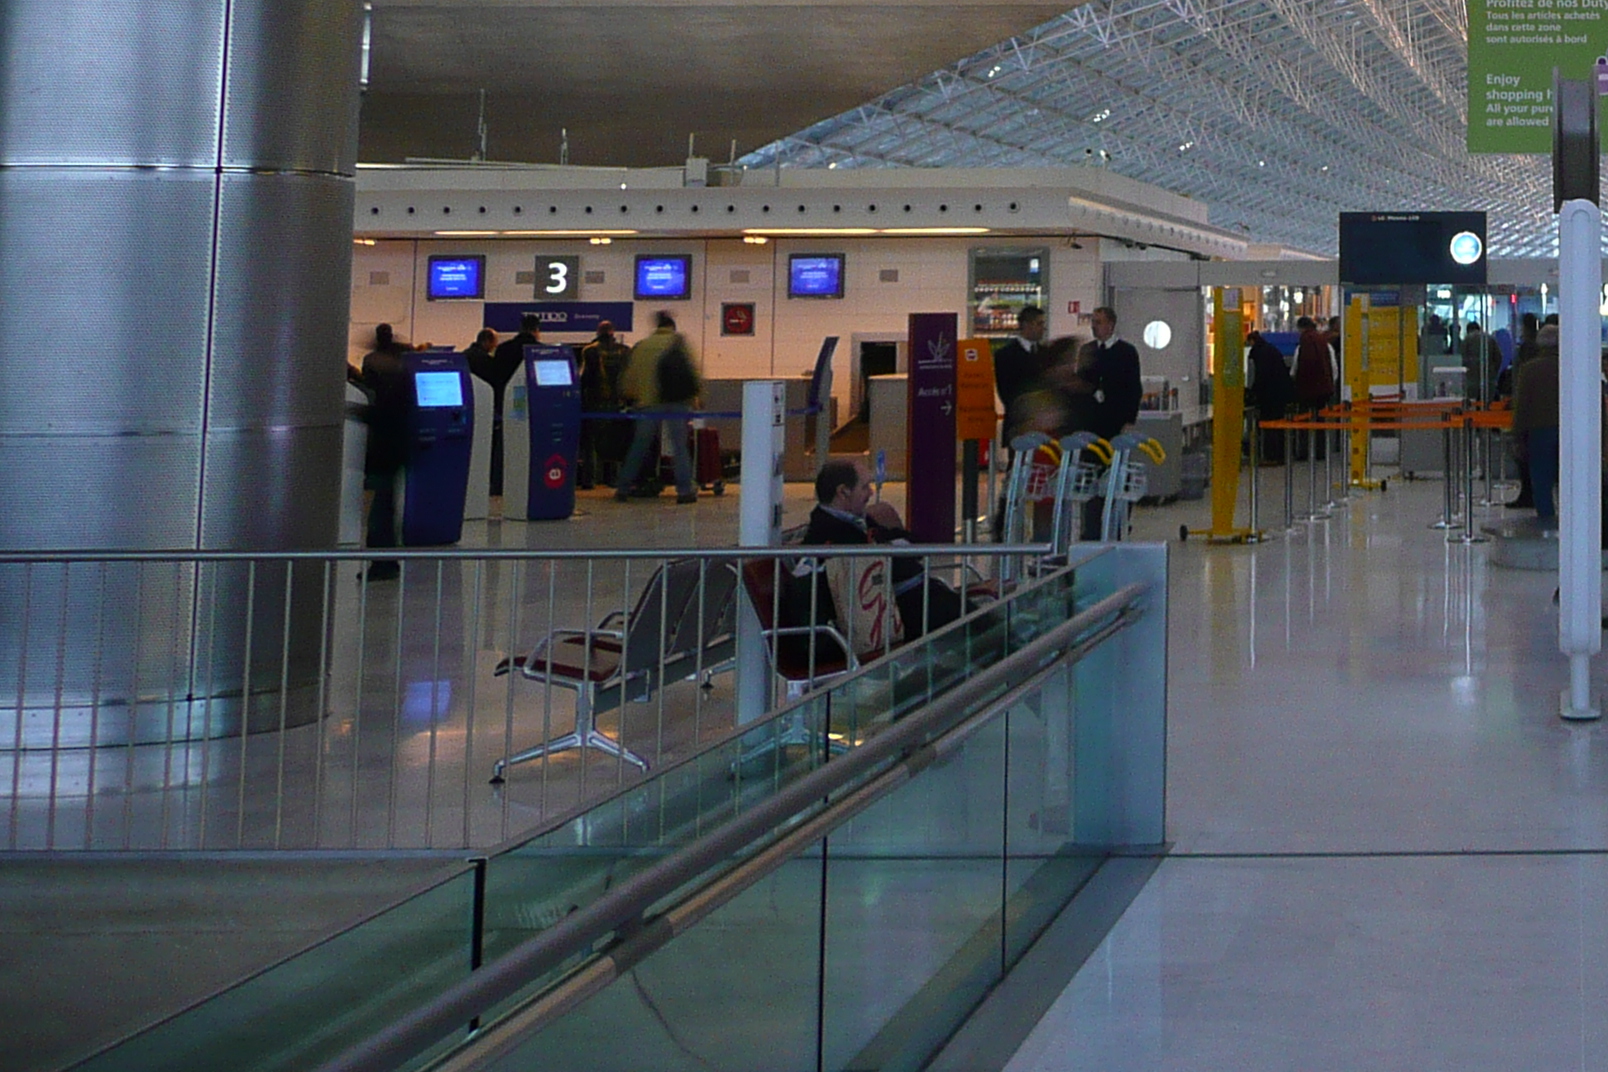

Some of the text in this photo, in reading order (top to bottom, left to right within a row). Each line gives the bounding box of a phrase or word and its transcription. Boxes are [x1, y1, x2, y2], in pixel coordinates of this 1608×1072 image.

[1556, 0, 1579, 8] nos
[1486, 11, 1601, 20] Tous les articles achetés
[1486, 23, 1562, 32] dans cette zone
[1486, 34, 1588, 44] sont autorisés à bord
[1486, 73, 1521, 87] Enjoy
[1486, 90, 1543, 103] shopping
[1486, 103, 1501, 113] All
[1503, 105, 1528, 116] your
[1486, 116, 1549, 127] are allowed
[546, 262, 568, 294] 3
